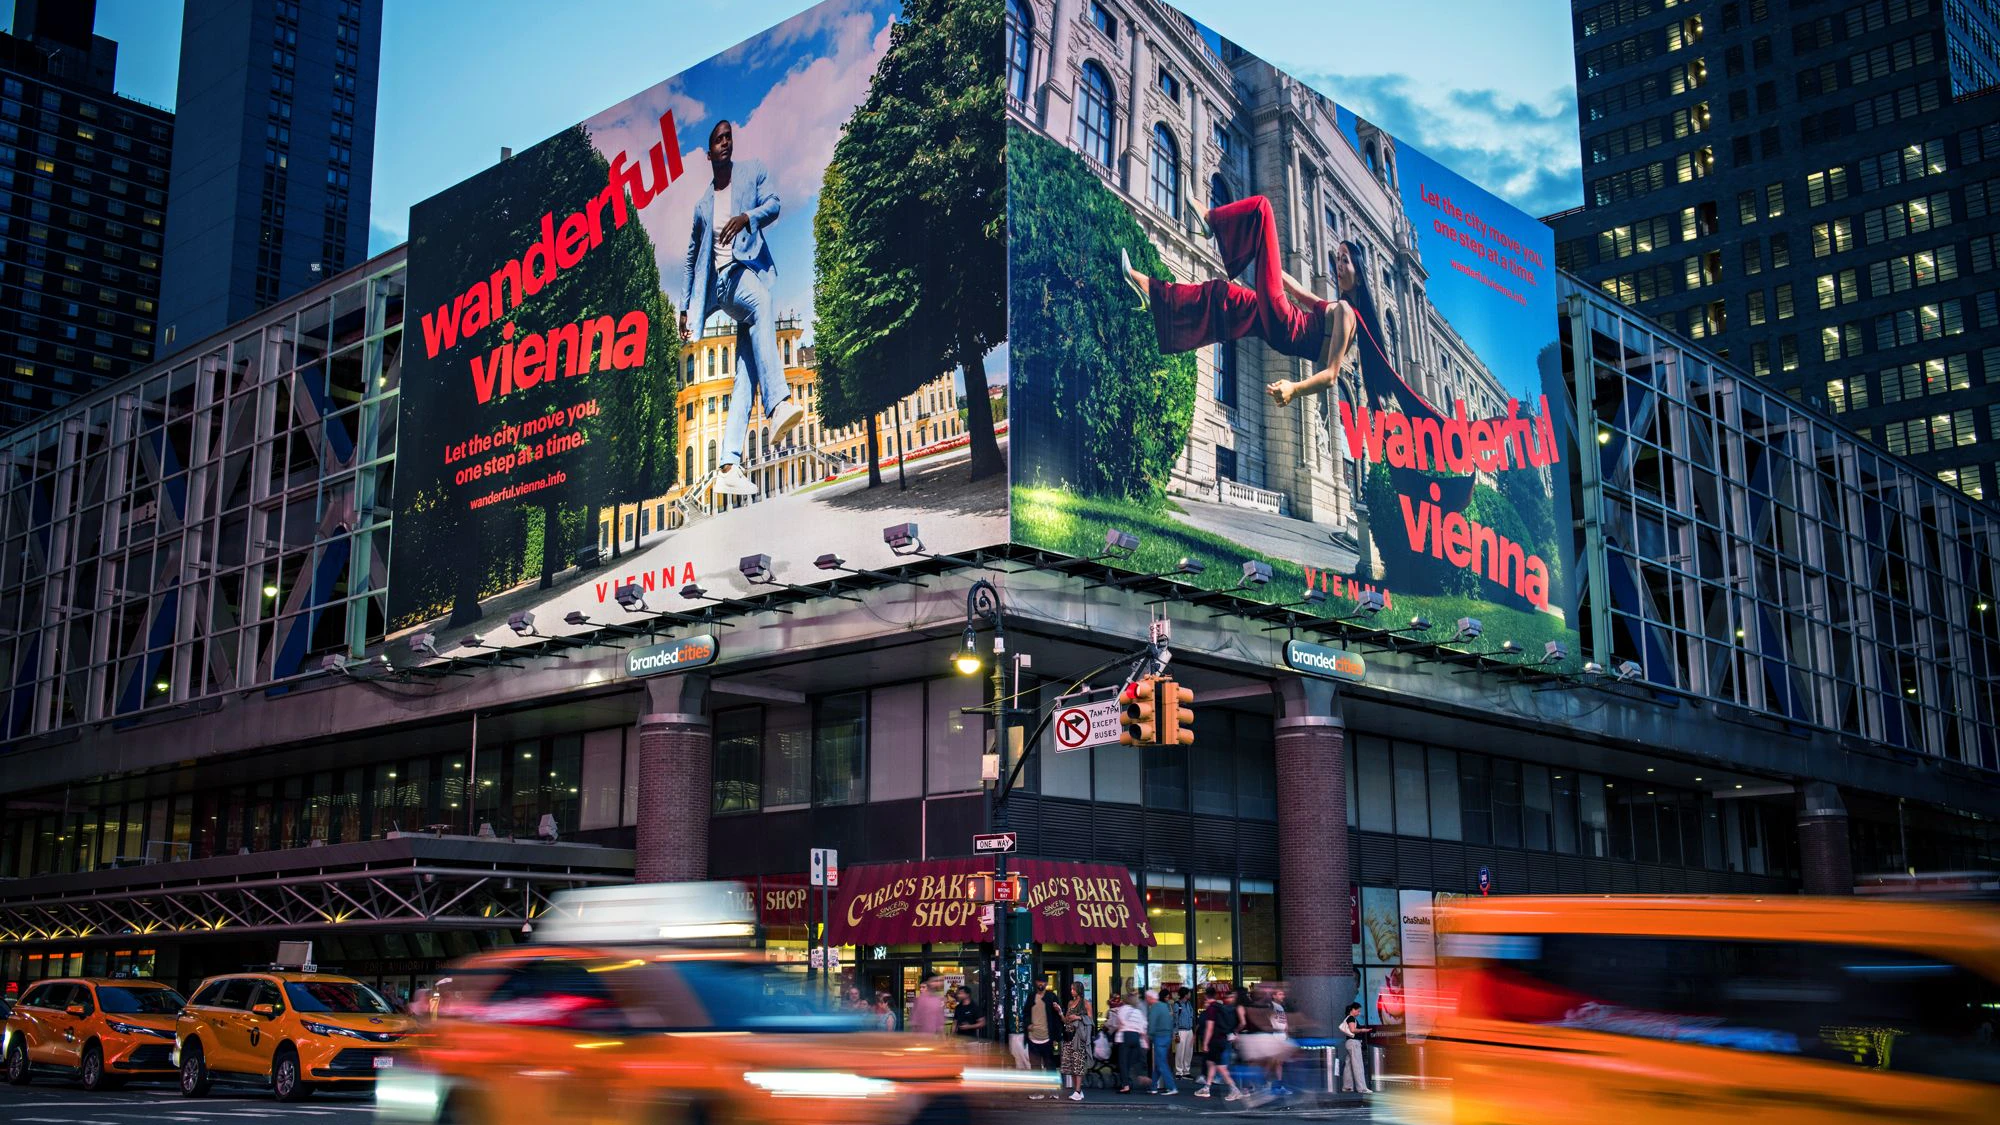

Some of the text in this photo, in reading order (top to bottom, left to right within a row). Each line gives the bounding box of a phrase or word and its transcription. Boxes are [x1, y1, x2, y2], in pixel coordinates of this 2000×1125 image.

[421, 108, 684, 360] wanderful
[1420, 184, 1440, 210] Let
[1442, 197, 1463, 222] the
[1465, 210, 1487, 238] city
[1489, 226, 1521, 255] move
[1433, 219, 1537, 286] one step at a time.
[1451, 259, 1527, 307] wanderful.vienna.info
[469, 310, 649, 406] vienna
[444, 399, 600, 464] Let the city move you,
[1338, 394, 1560, 474] wanderful
[455, 431, 585, 486] one step at a time.
[469, 470, 567, 510] wanderful.vienna.info
[1398, 482, 1549, 612] vienna
[630, 644, 712, 672] brandedcities
[1292, 647, 1363, 676] brandedcities
[1089, 706, 1119, 718] 7AM-7PM
[1092, 718, 1117, 729] EXCEPT
[1095, 729, 1117, 739] BUSES
[979, 839, 1010, 849] ONE WAY
[766, 889, 807, 910] SHOP
[847, 874, 967, 927] CARLO'S BAK
[879, 901, 898, 915] SINCE
[1027, 876, 1125, 909] ARLO'S BAKE
[1044, 900, 1059, 910] SINCE
[912, 901, 976, 927] SHOP
[1076, 903, 1130, 928] SHOP
